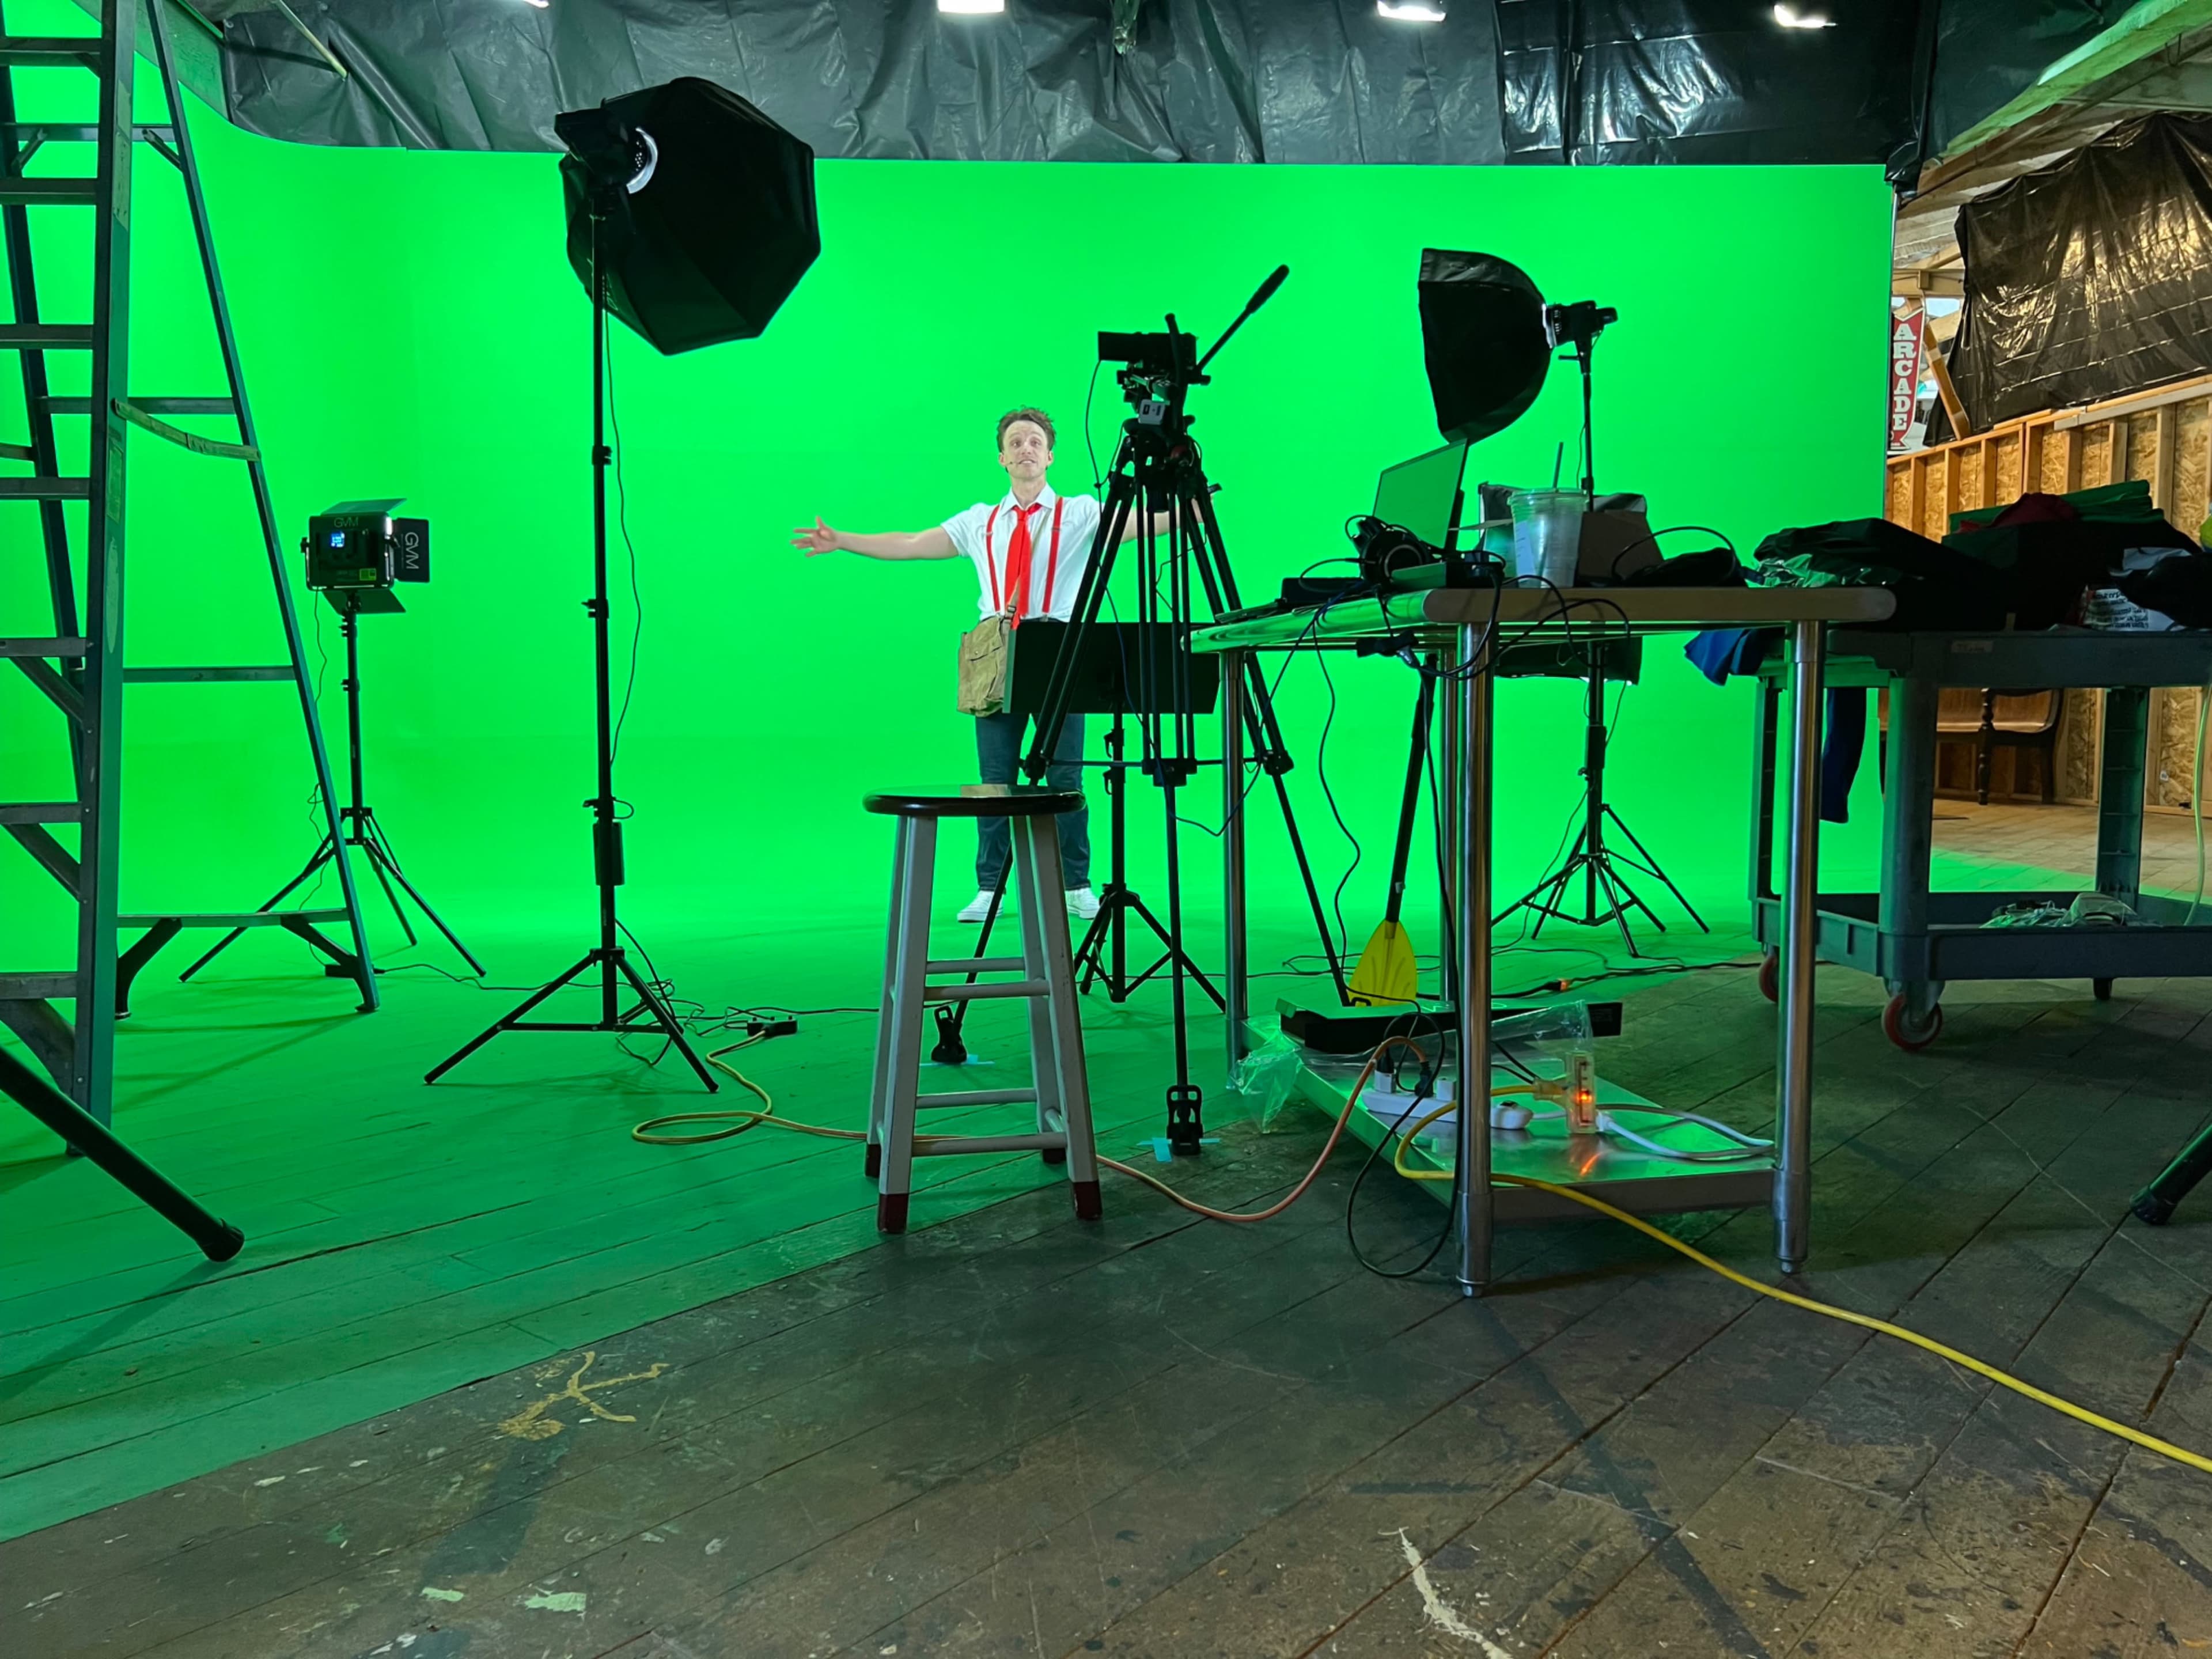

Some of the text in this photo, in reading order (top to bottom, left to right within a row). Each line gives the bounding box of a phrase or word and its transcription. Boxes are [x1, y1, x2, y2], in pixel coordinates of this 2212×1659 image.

[1893, 323, 1917, 430] ARCADE
[334, 517, 358, 527] GVM
[405, 532, 419, 569] GVM
